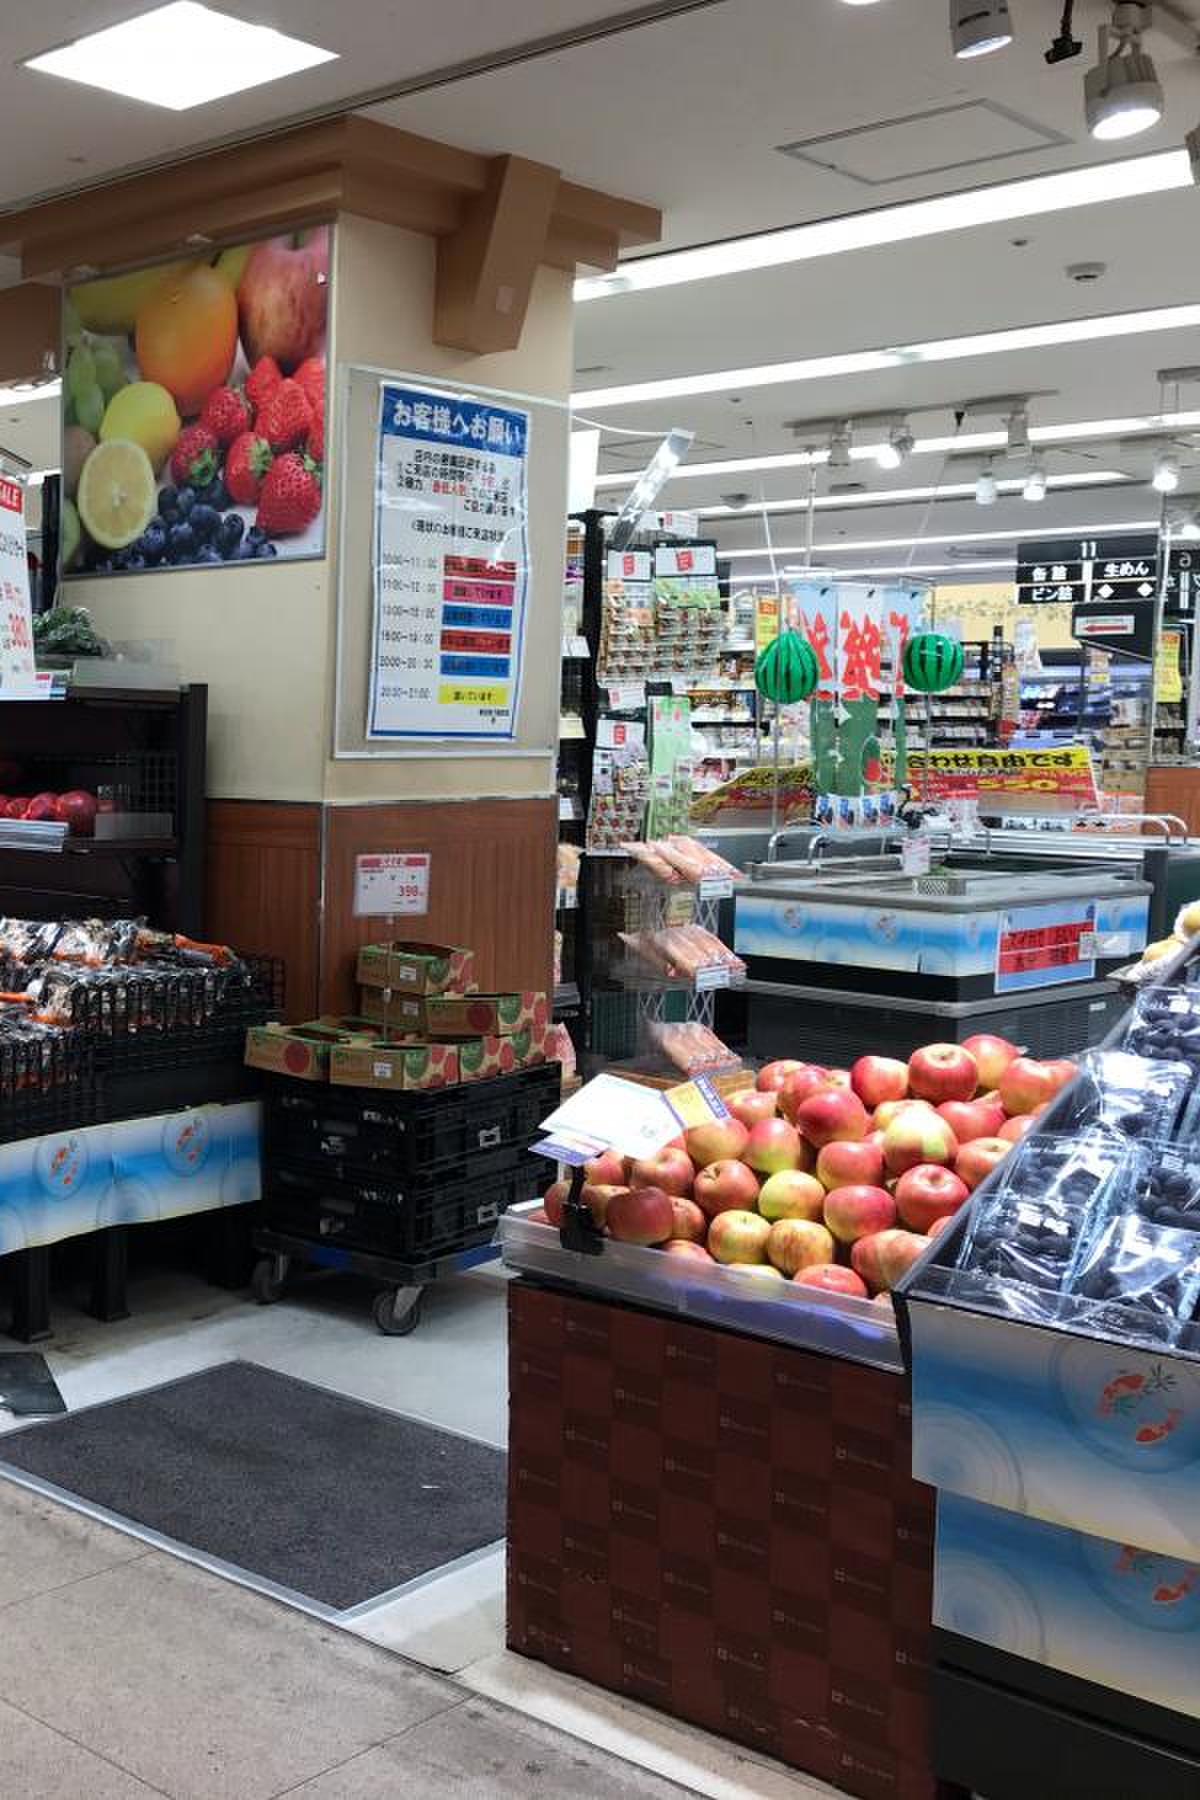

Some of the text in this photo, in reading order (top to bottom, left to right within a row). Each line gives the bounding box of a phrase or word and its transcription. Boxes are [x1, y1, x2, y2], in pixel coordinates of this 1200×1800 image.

[393, 400, 521, 446] お客様へお願い
[1080, 541, 1097, 558] 11
[1104, 561, 1149, 578] 生めん
